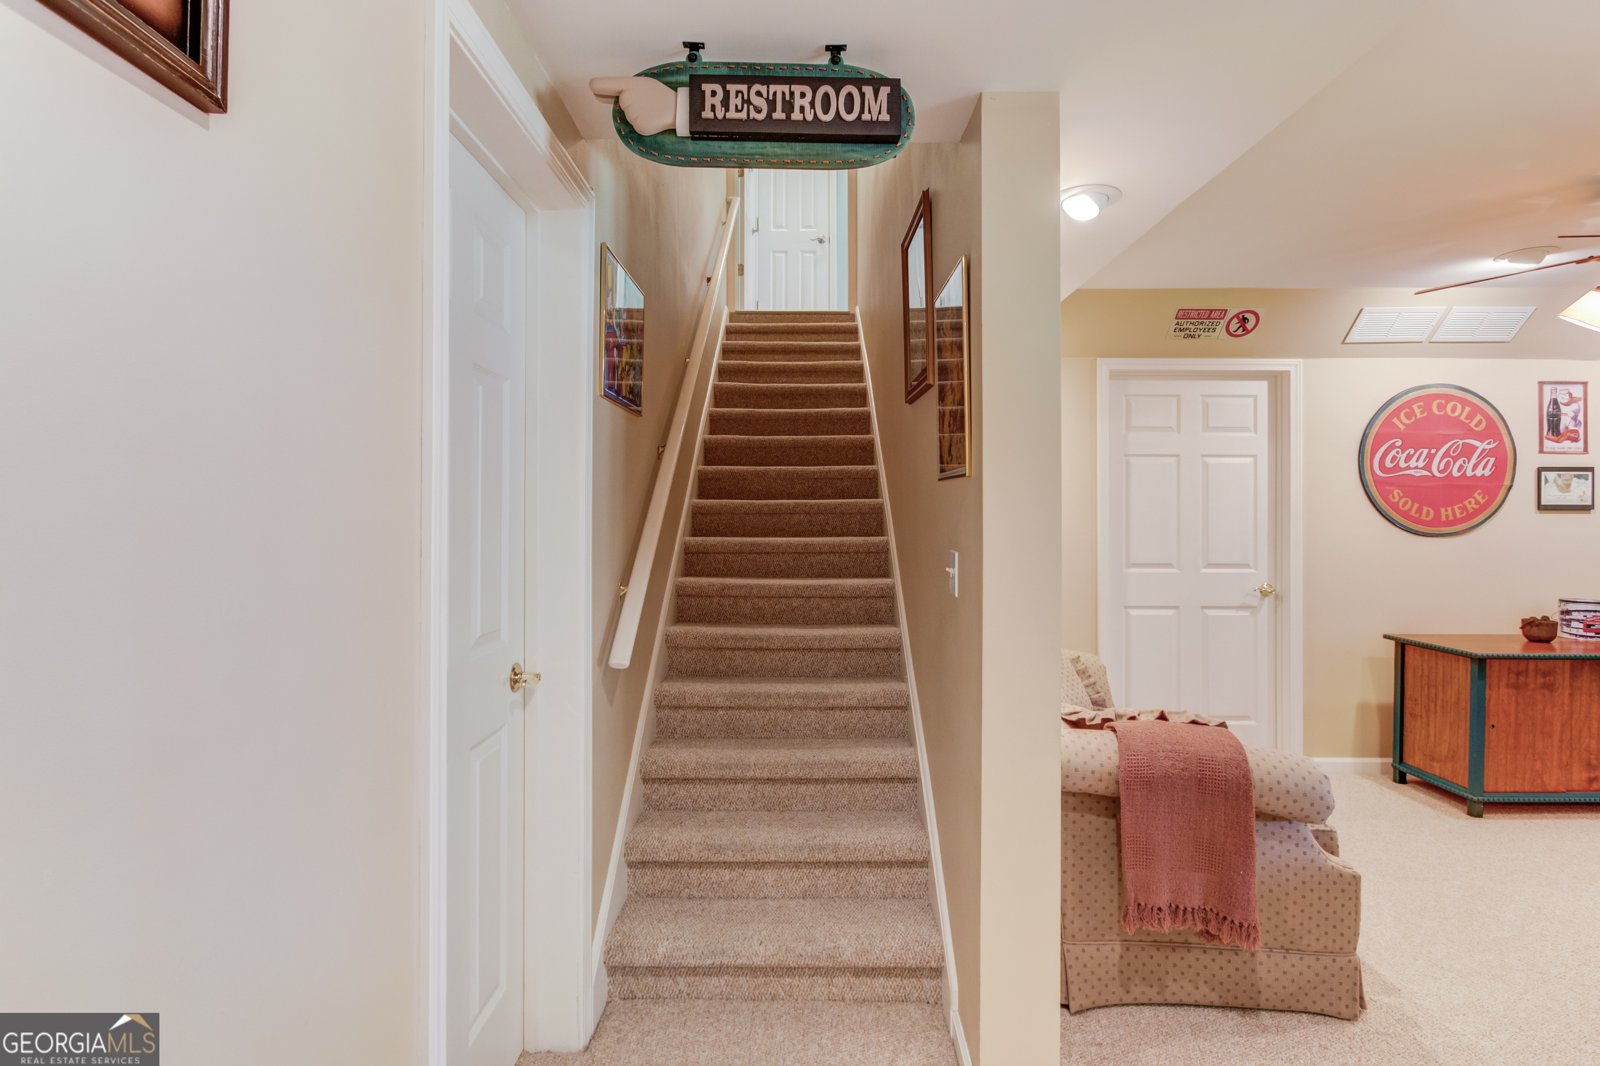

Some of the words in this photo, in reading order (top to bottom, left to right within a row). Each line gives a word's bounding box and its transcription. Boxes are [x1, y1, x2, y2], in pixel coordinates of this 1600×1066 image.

[701, 83, 891, 122] RESTROOM
[1177, 310, 1210, 319] RESTRICTED
[1210, 310, 1226, 319] AREA
[1392, 402, 1428, 431] ICE
[1431, 399, 1487, 432] COLD
[1373, 438, 1499, 478] Coca-Cola
[1388, 489, 1435, 521] SOLD
[1440, 489, 1489, 522] HERE
